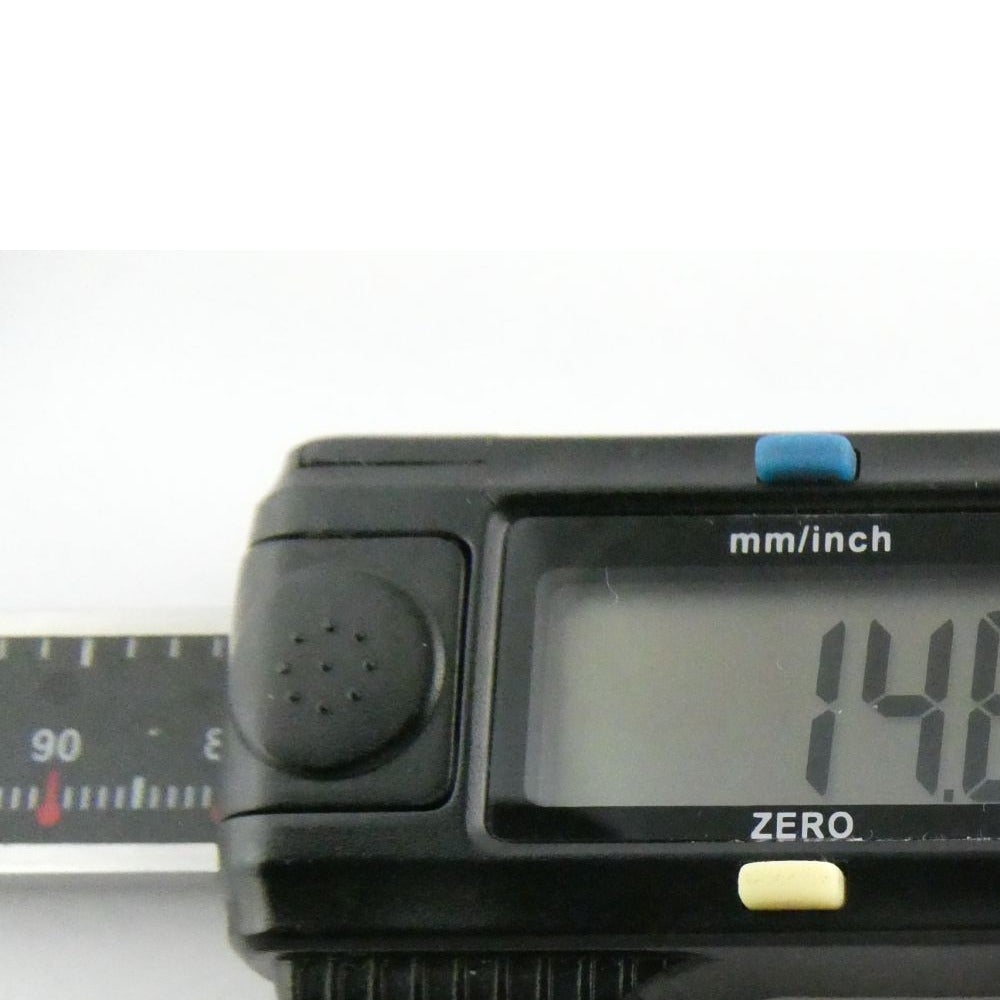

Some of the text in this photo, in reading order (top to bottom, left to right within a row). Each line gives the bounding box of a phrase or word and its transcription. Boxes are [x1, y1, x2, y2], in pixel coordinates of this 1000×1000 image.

[730, 524, 892, 554] mm/inch
[31, 728, 82, 763] 90
[750, 811, 854, 839] ZERO
